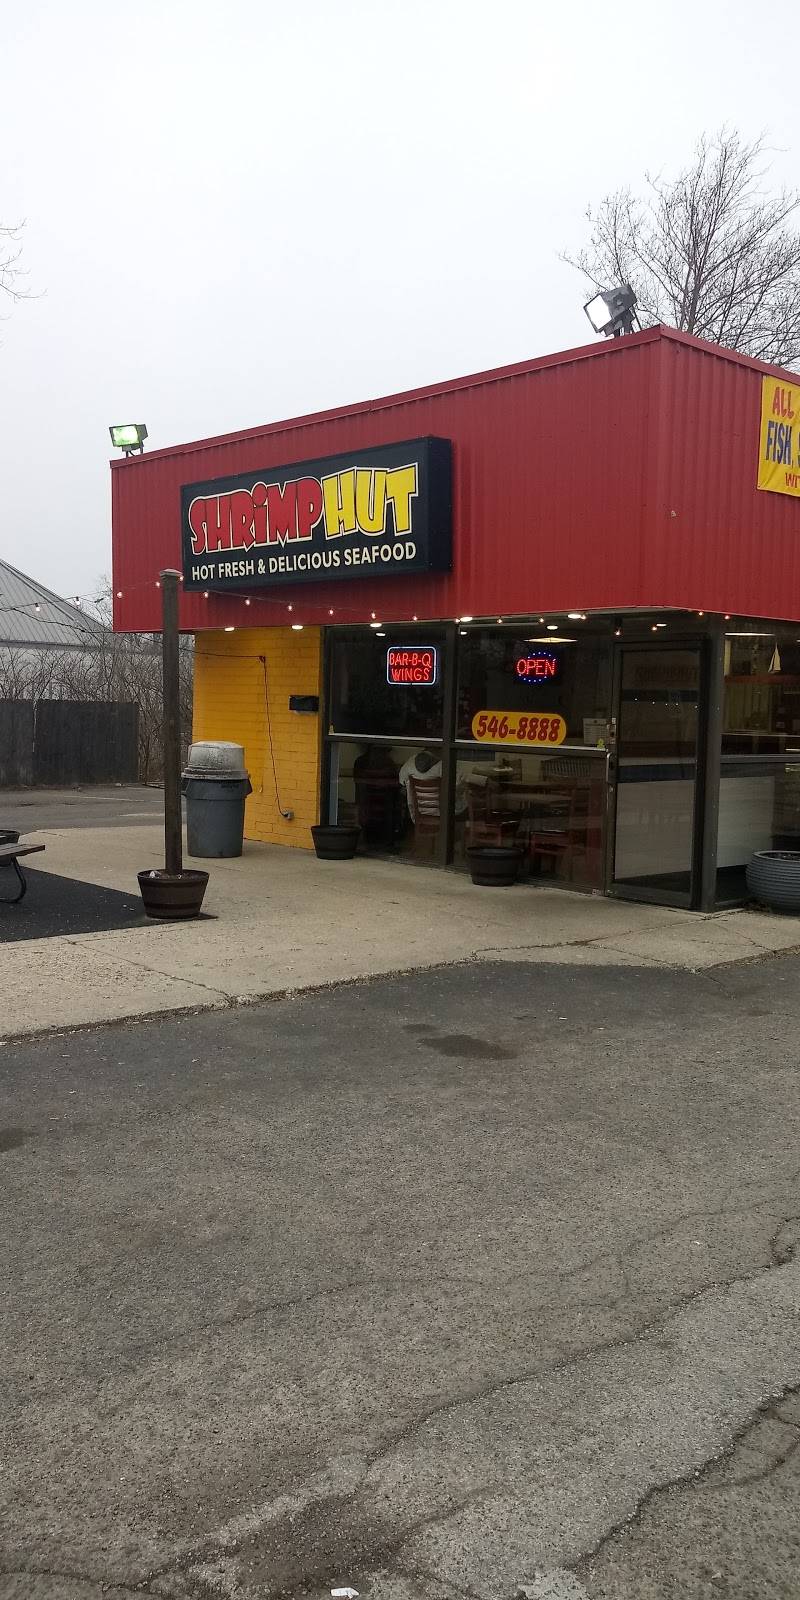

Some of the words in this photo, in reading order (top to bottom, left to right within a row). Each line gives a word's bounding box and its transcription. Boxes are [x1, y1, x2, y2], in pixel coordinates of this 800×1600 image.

[772, 386, 795, 419] ALL
[192, 565, 215, 581] HOT
[218, 560, 254, 578] FRESH
[257, 558, 266, 574] &
[269, 550, 340, 573] DELICIOUS
[344, 541, 416, 566] SEAFOOD
[389, 652, 432, 668] BAR-B-Q
[516, 659, 556, 676] OPEN
[391, 667, 430, 681] WINGS
[476, 715, 561, 742] 546-8888
